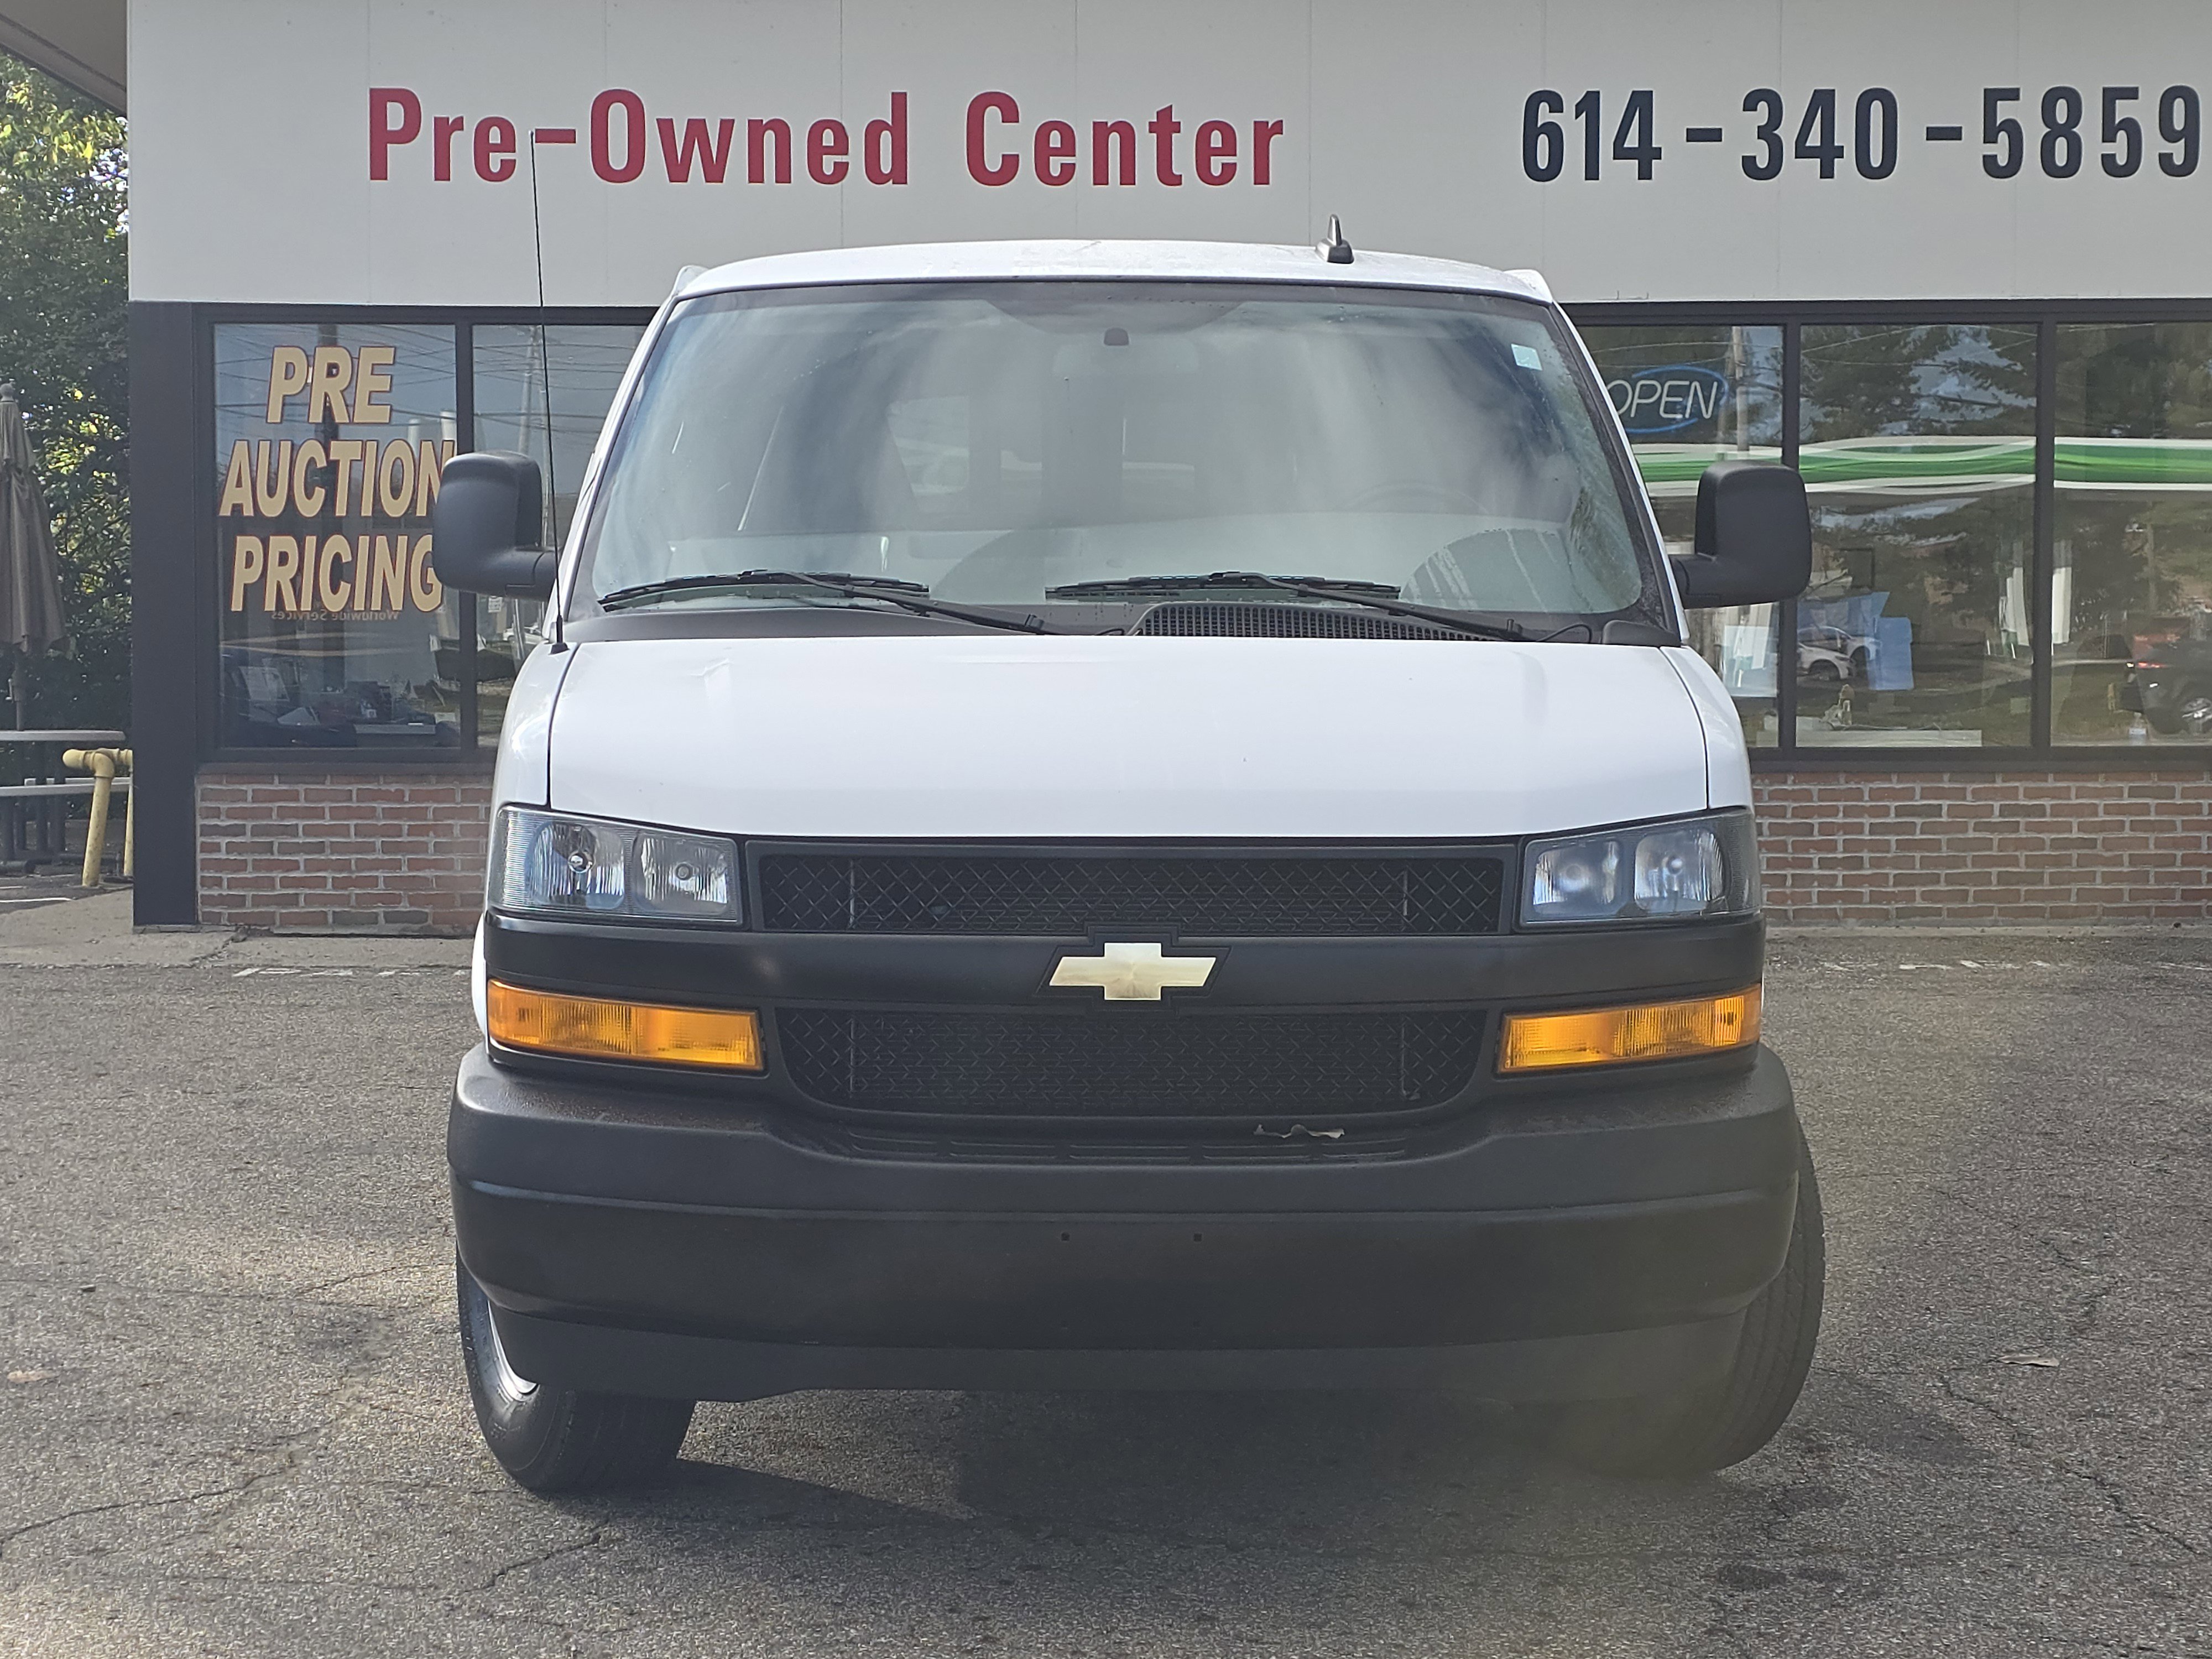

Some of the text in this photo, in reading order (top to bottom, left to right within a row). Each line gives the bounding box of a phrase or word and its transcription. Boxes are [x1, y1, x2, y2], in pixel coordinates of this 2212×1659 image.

[369, 87, 1283, 186] Pre-Owned Center
[266, 346, 395, 424] PRE
[1607, 379, 1718, 419] OPEN
[220, 439, 455, 518] AUCTION
[231, 534, 441, 612] PRICING
